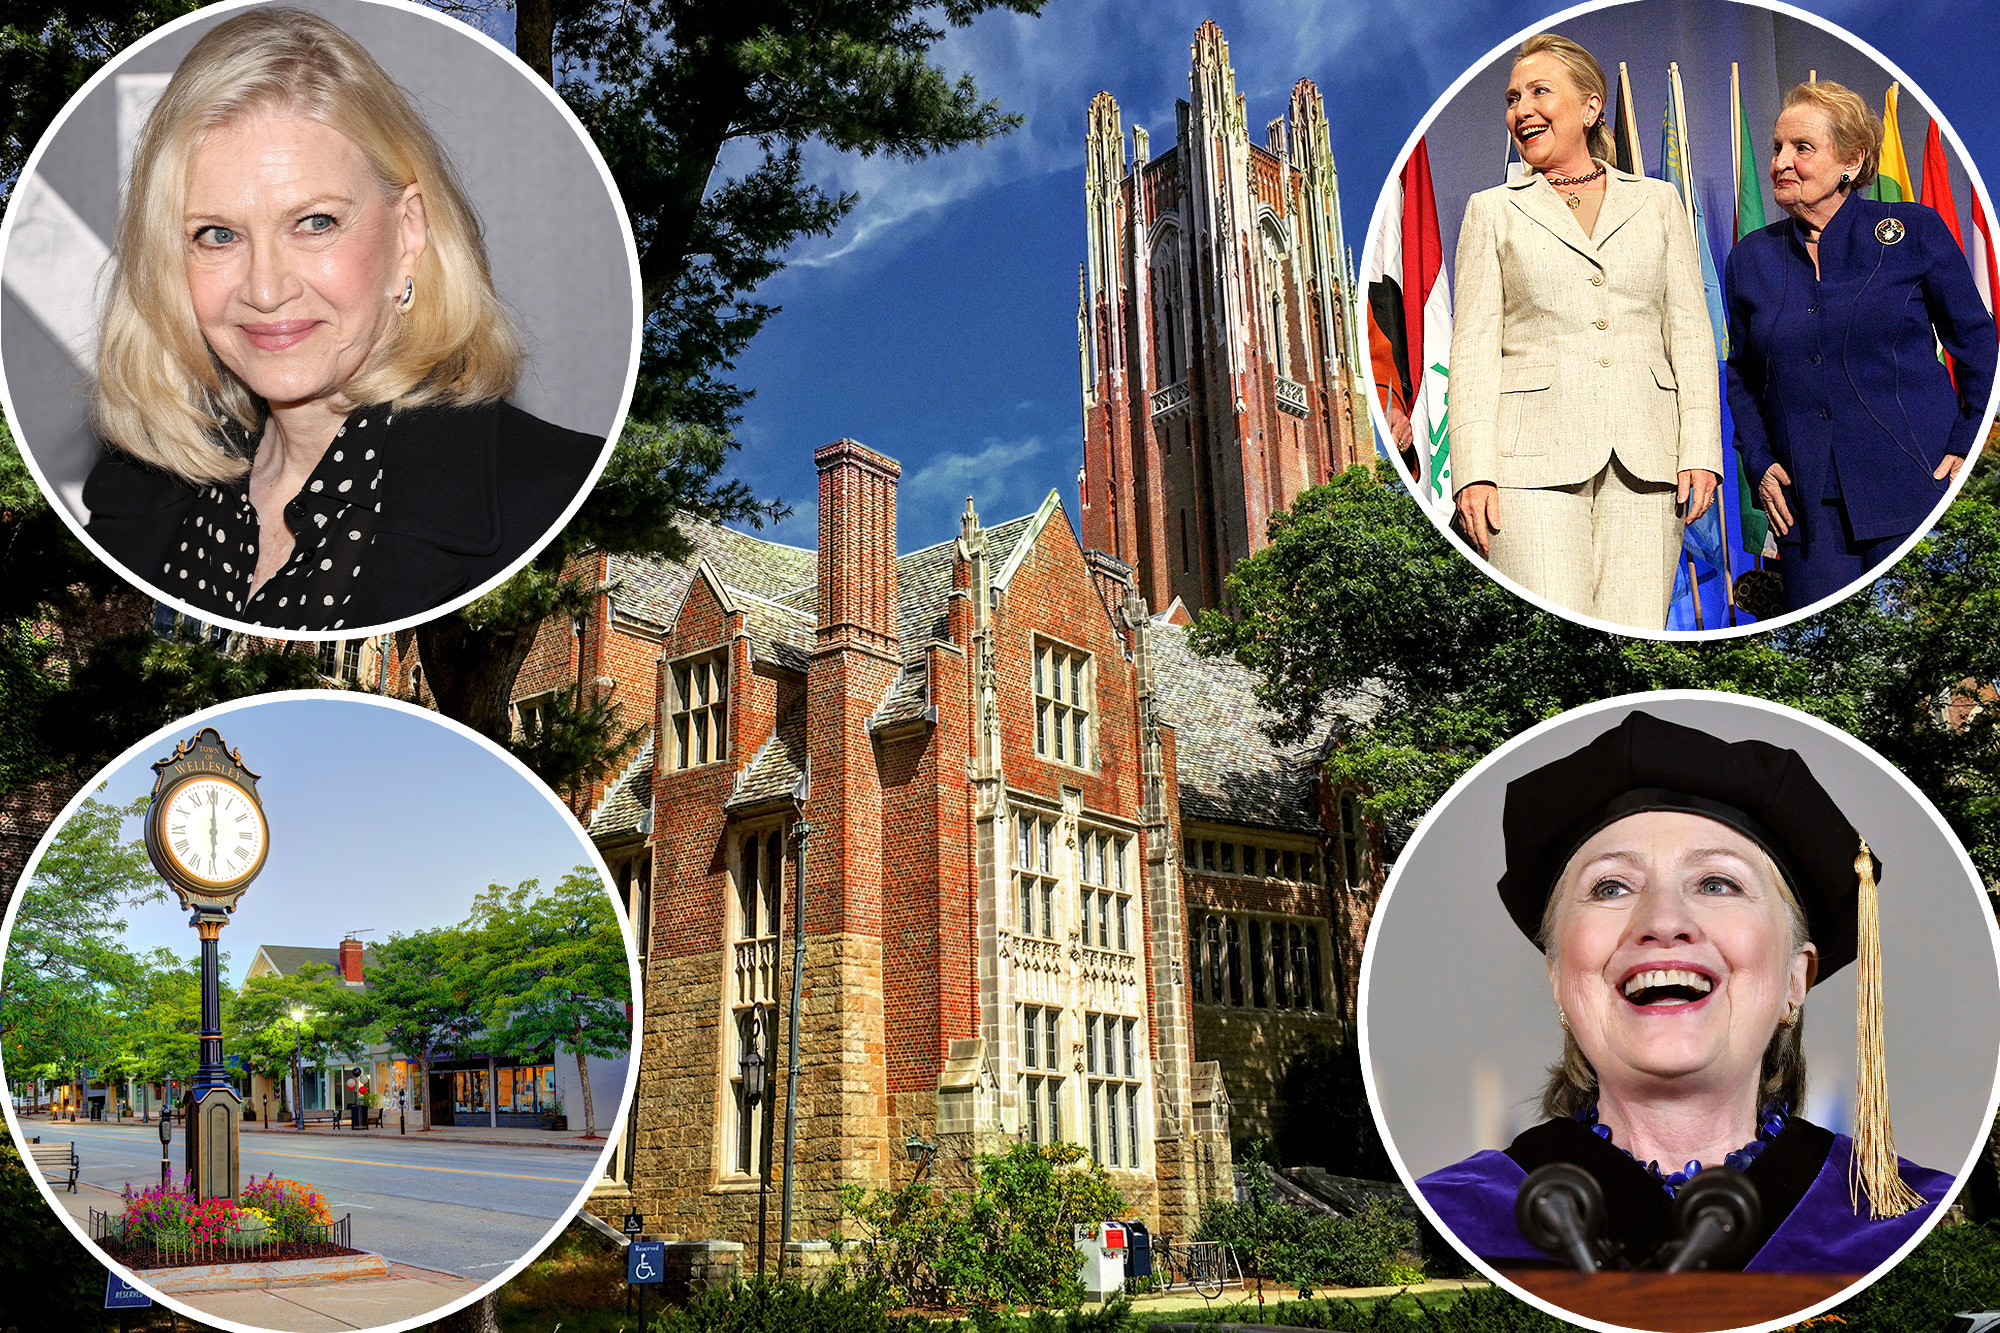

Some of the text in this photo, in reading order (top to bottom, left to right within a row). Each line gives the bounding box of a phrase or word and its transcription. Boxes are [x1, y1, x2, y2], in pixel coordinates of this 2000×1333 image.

[199, 745, 220, 754] TOWN
[174, 760, 243, 781] WELLESLEY
[193, 892, 208, 903] INC
